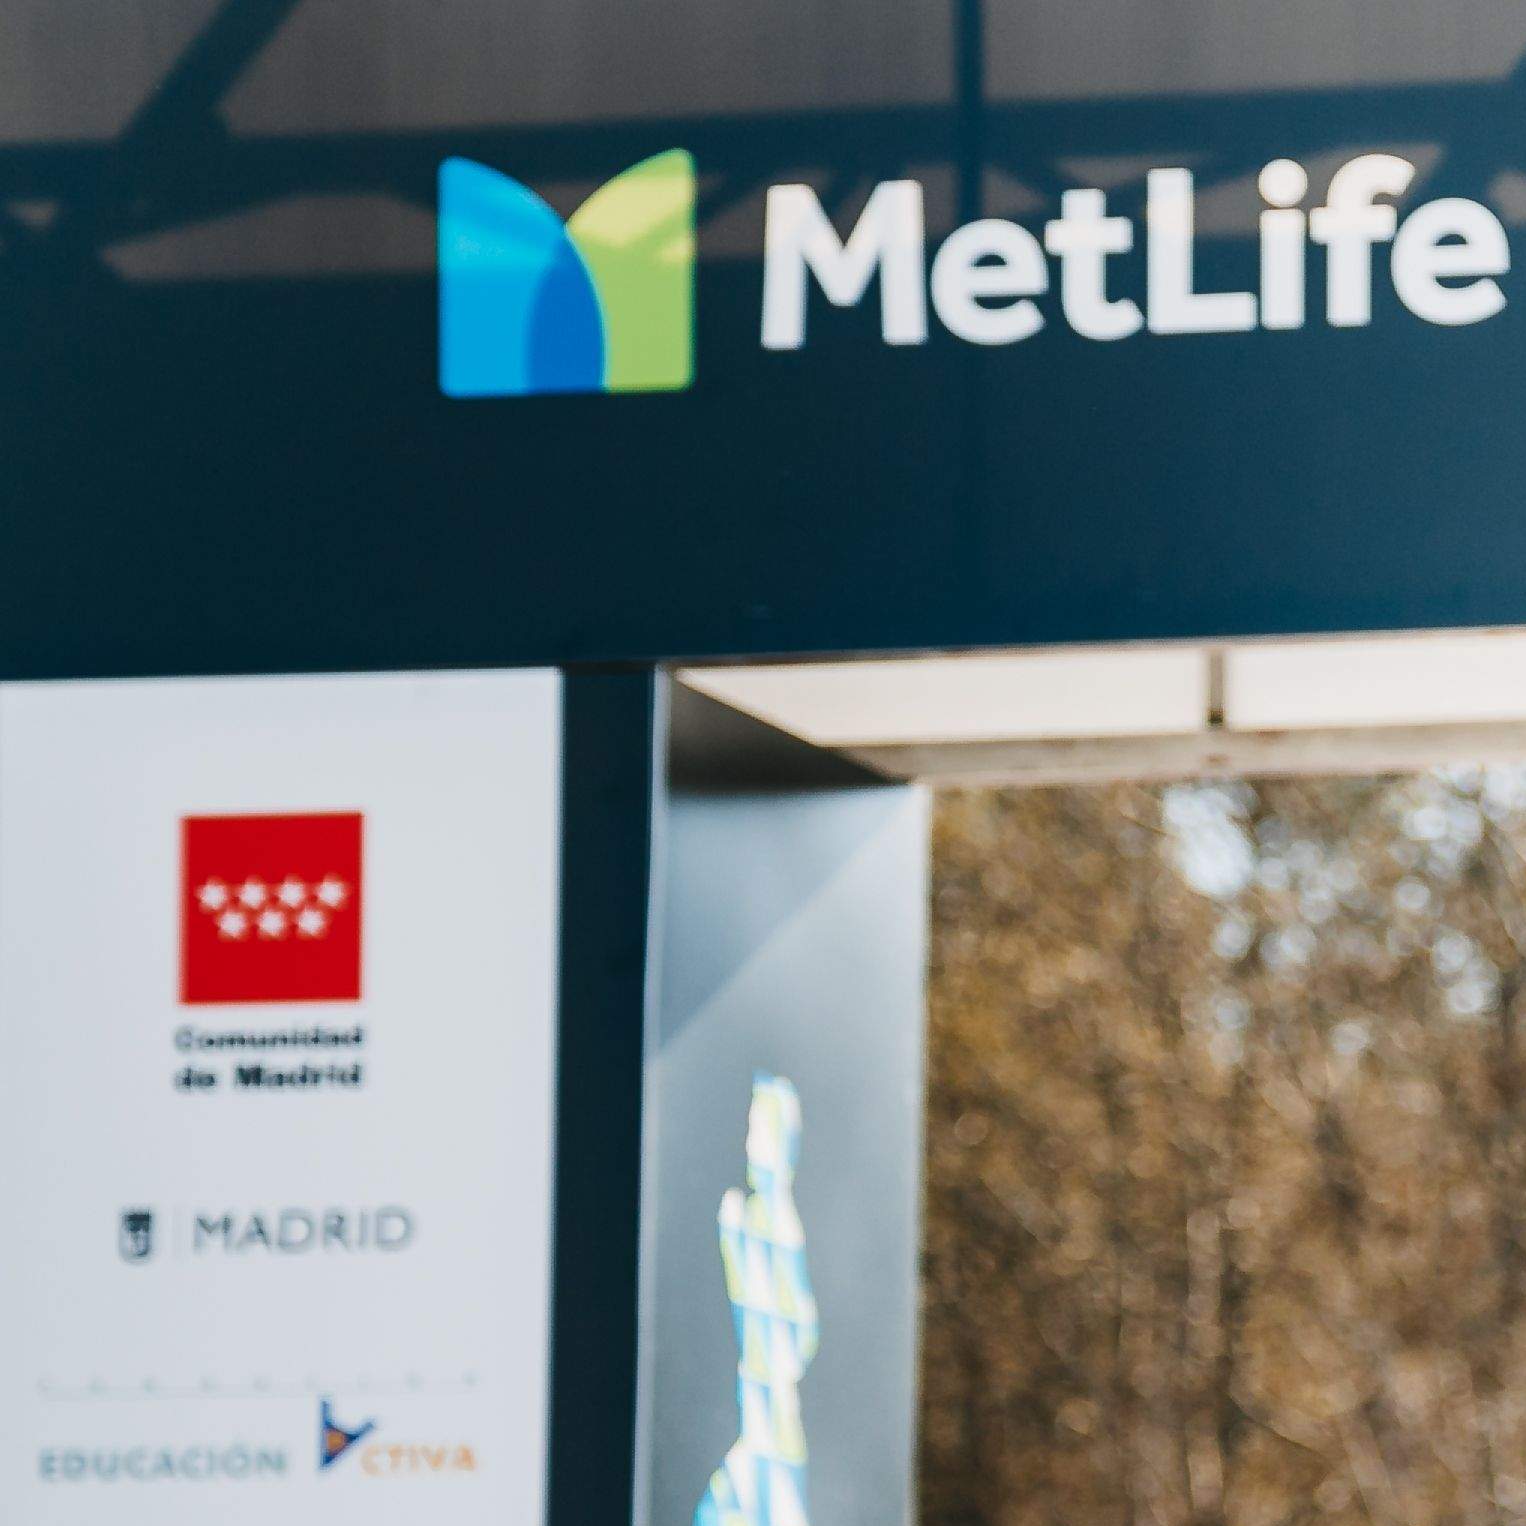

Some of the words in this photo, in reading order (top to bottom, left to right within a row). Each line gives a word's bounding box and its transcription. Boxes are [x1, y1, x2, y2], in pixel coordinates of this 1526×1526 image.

[759, 152, 1512, 350] MetLife
[236, 1063, 363, 1088] Madrid
[193, 1207, 415, 1254] MADRID
[38, 1440, 288, 1482] EDUCACIÓN
